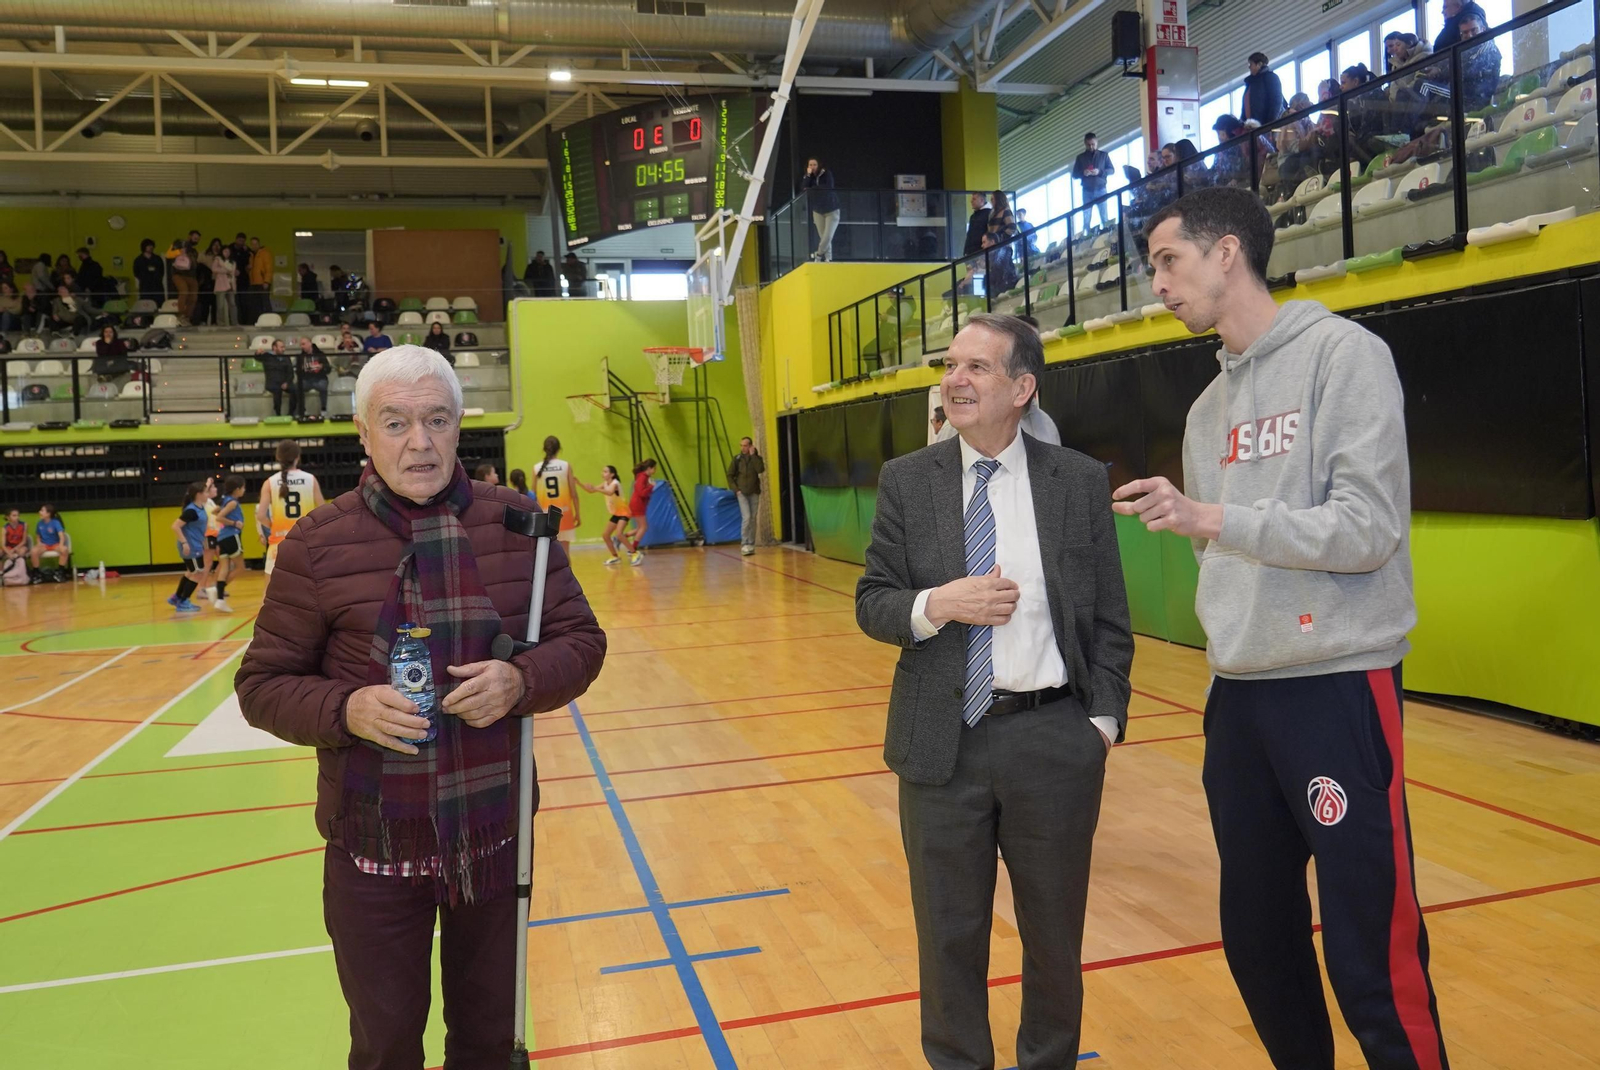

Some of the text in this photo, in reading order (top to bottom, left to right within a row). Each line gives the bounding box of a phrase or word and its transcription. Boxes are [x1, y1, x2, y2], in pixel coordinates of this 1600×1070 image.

[621, 115, 637, 125] LOCAL
[721, 108, 727, 117] 2
[721, 117, 727, 126] 3
[654, 126, 663, 145] E
[690, 118, 701, 140] 0
[633, 128, 645, 150] 0
[721, 136, 726, 144] 5
[636, 159, 685, 187] 04:55
[684, 176, 707, 185] MONDO
[715, 199, 725, 208] 34
[545, 477, 559, 498] 9
[285, 491, 301, 518] 8
[1322, 800, 1333, 818] 6
